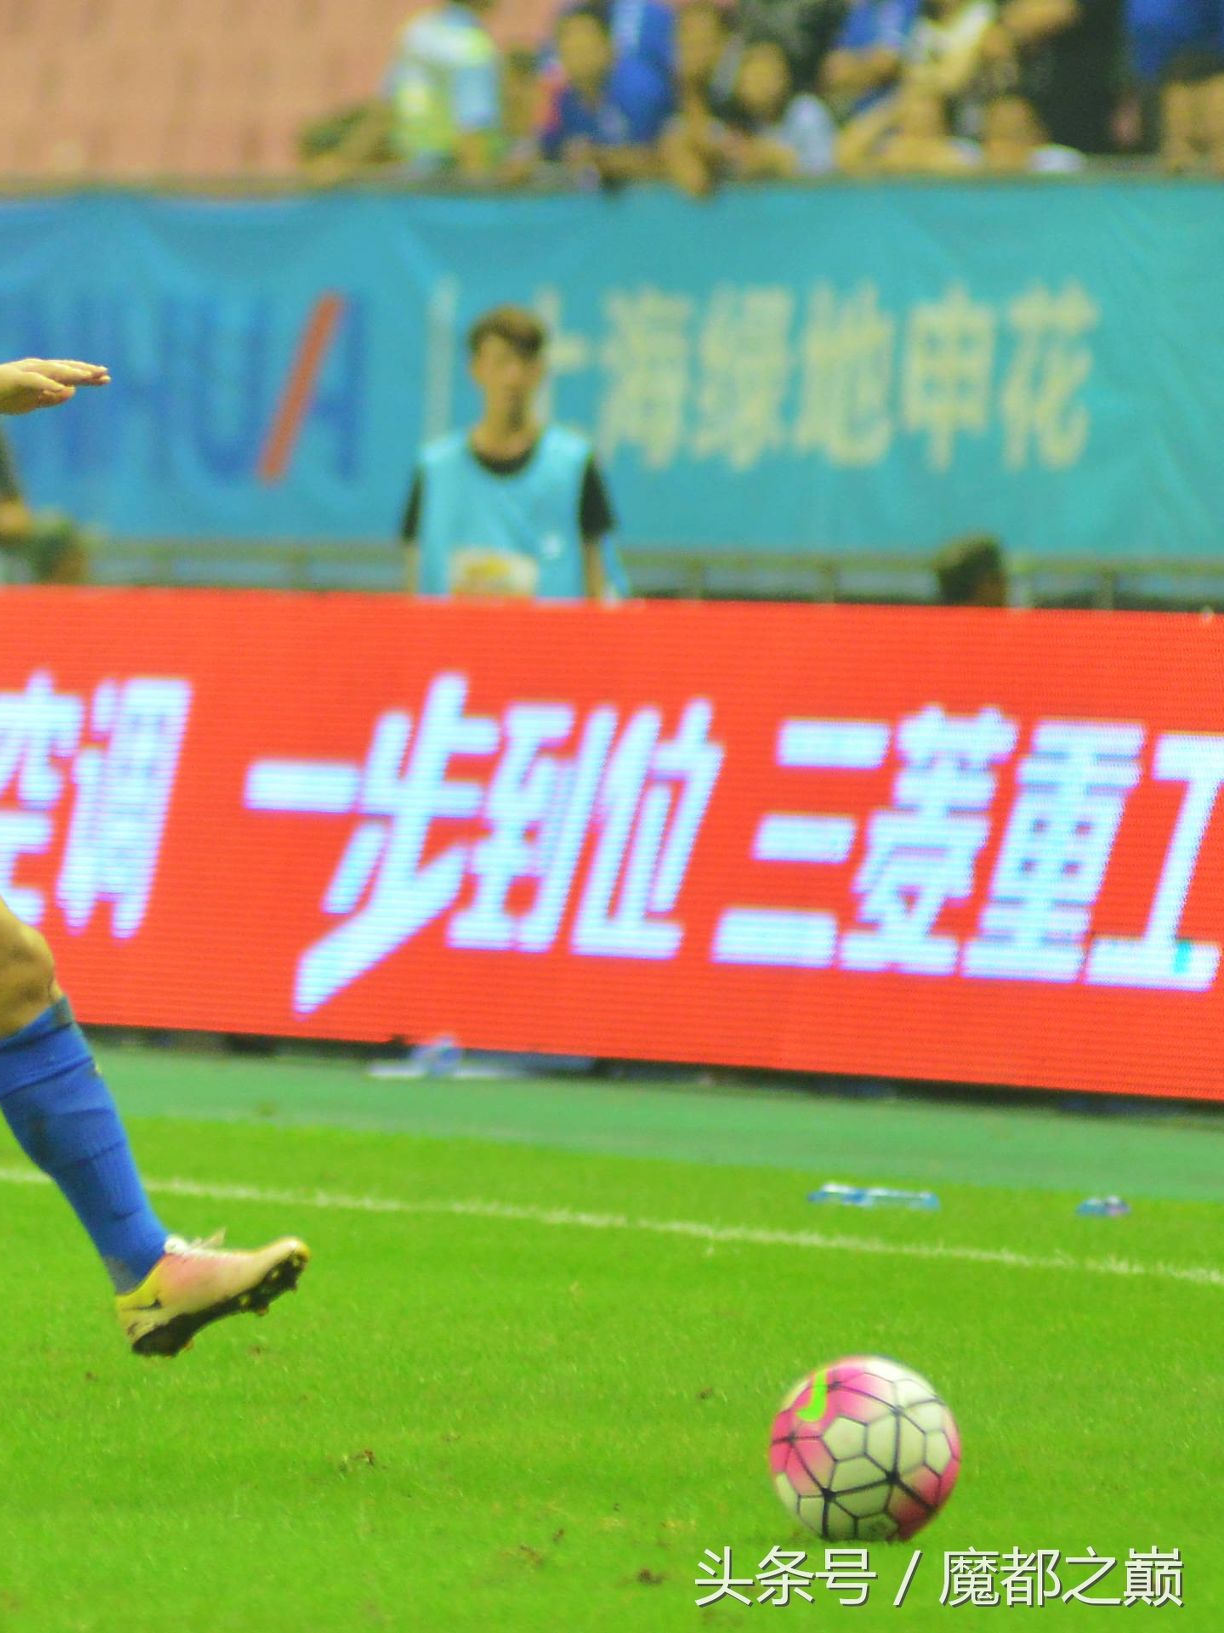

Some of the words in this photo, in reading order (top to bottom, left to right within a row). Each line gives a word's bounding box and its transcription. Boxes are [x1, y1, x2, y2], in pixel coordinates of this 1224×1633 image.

[244, 671, 724, 1017] 一步到位
[711, 700, 1224, 991] 三菱重工
